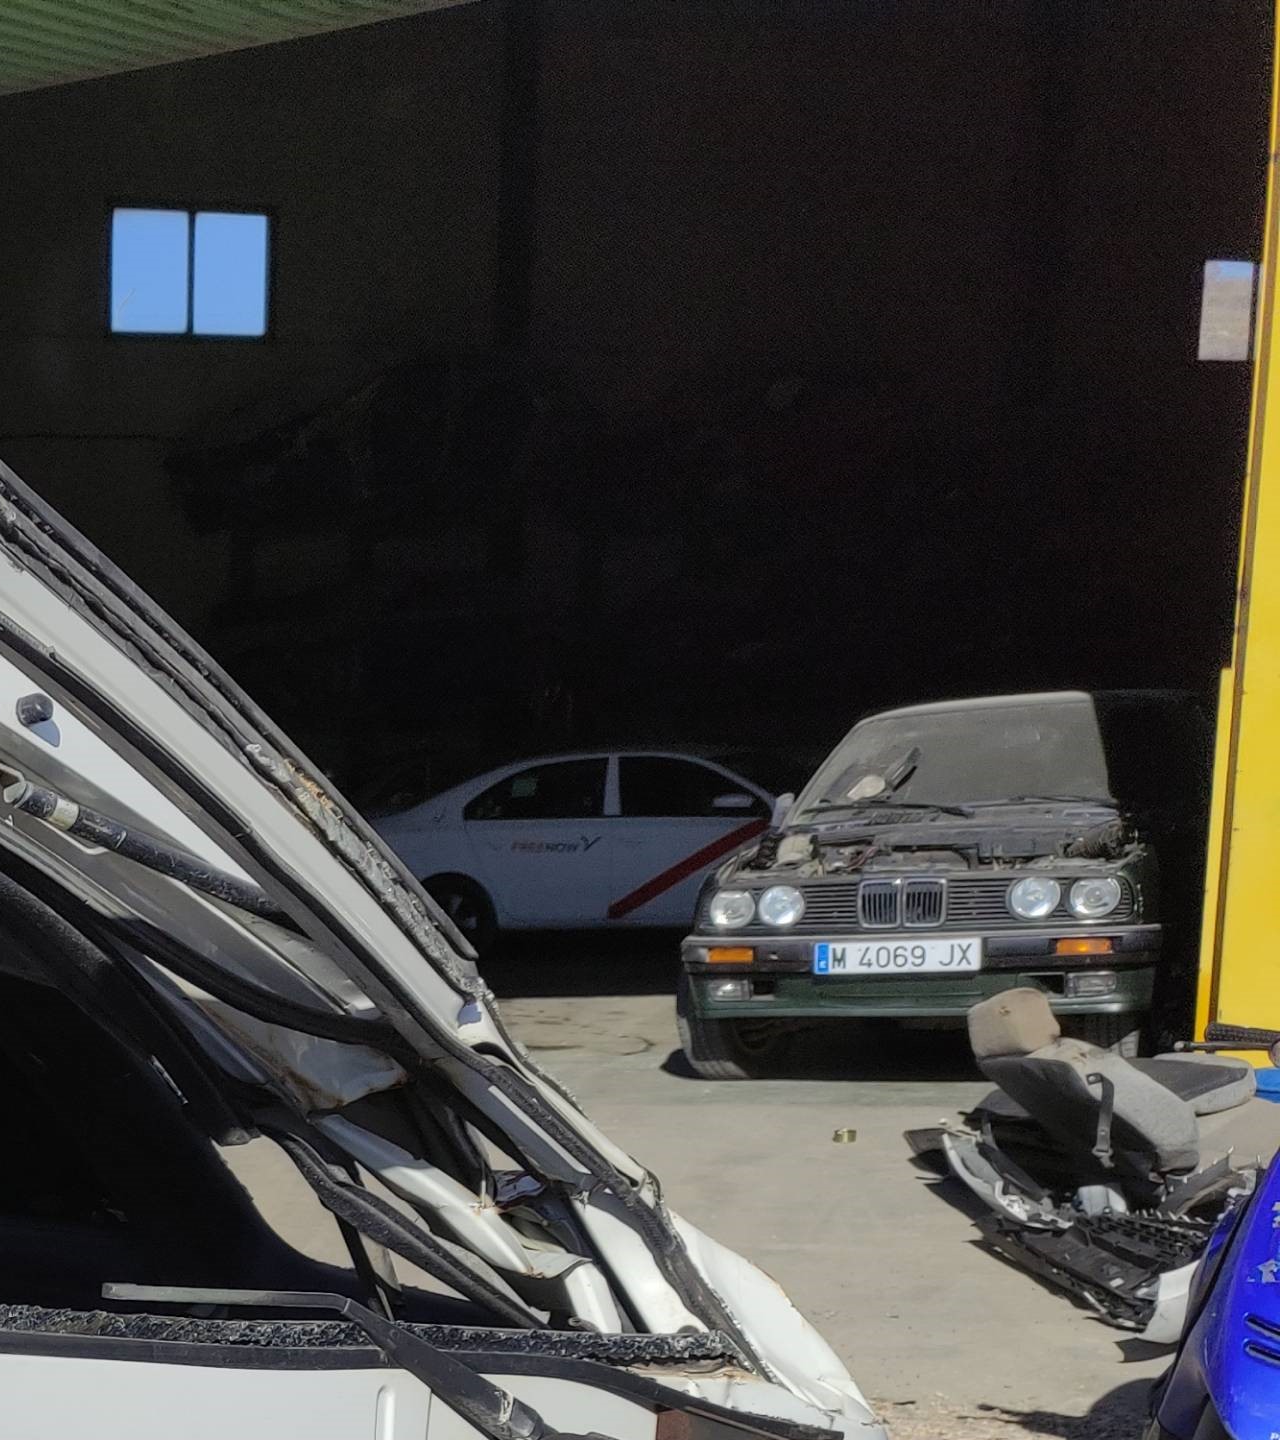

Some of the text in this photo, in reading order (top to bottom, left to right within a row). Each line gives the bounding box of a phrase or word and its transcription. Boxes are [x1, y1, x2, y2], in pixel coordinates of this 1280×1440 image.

[832, 942, 973, 970] M 4069 JX
